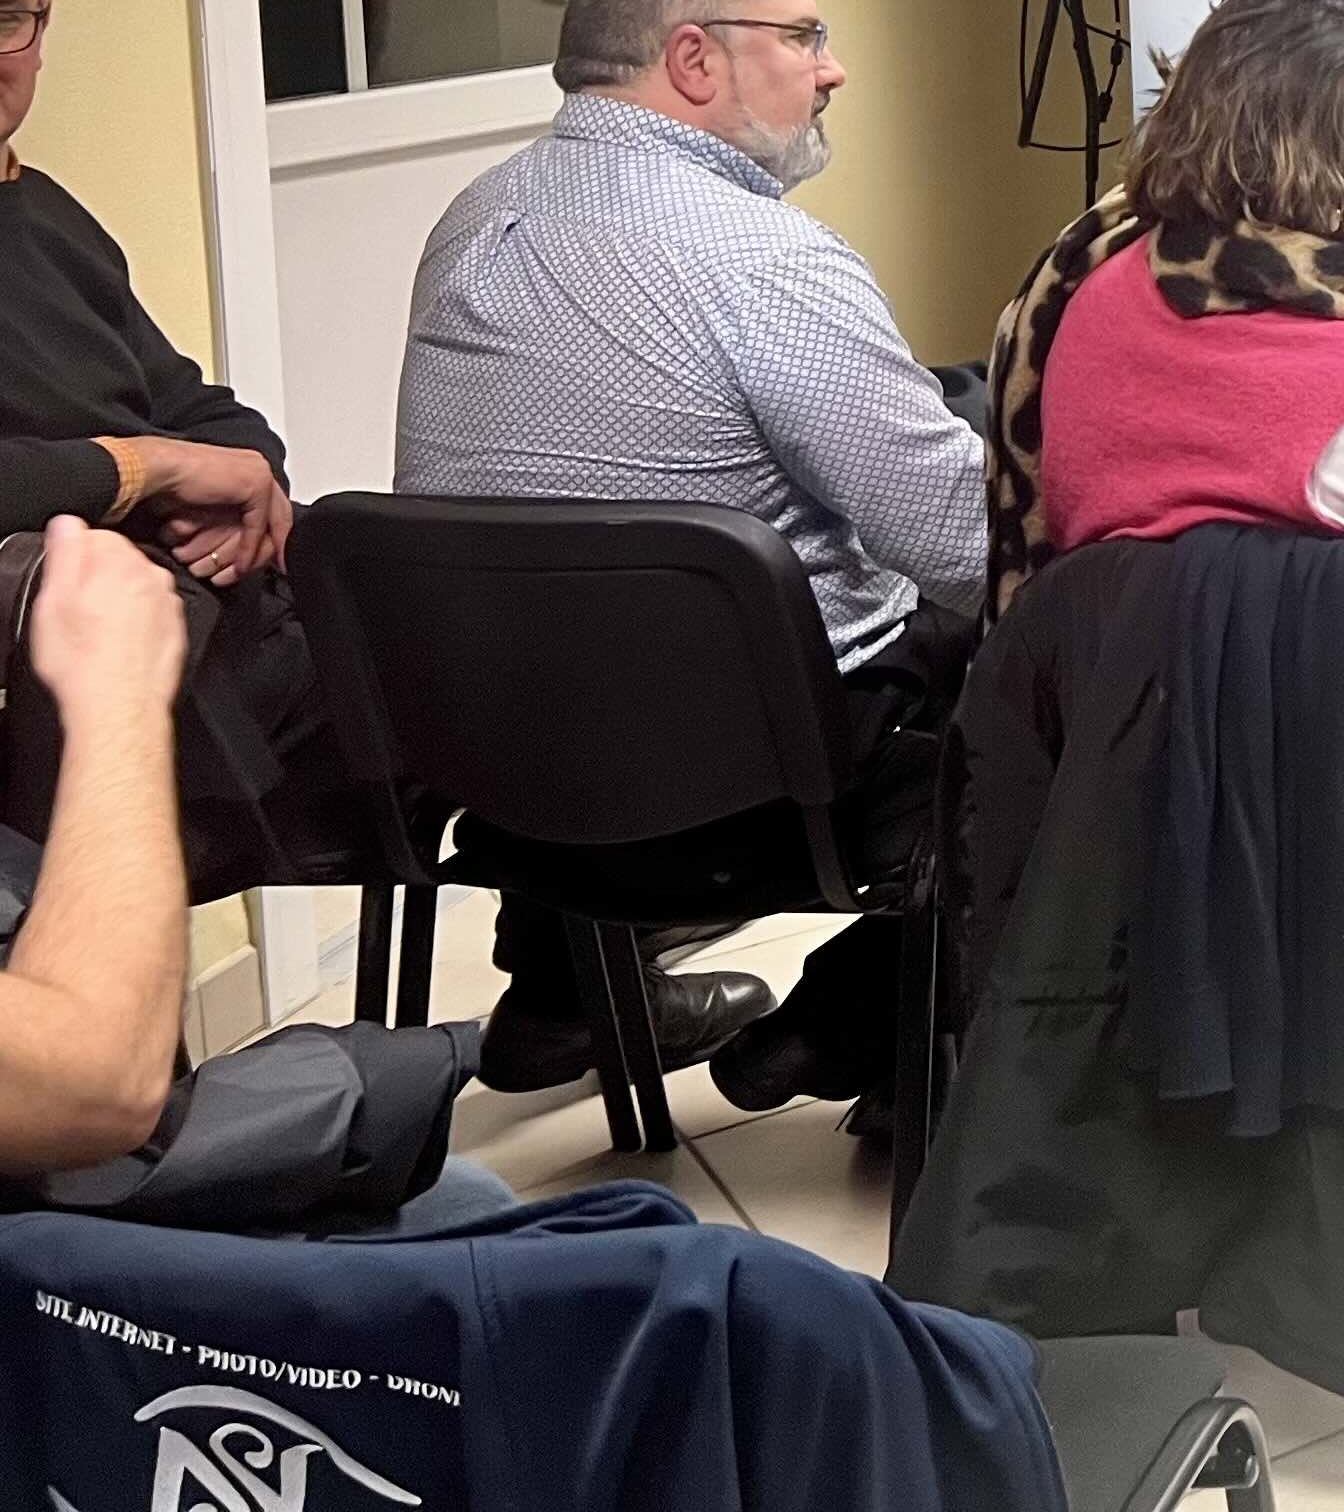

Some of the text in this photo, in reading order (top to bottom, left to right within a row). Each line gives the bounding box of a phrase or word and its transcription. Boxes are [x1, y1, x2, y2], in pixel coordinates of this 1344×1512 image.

[35, 1289, 74, 1325] SITE
[75, 1306, 177, 1355] INTERNET
[197, 1344, 362, 1390] PHOTO/VIDEO
